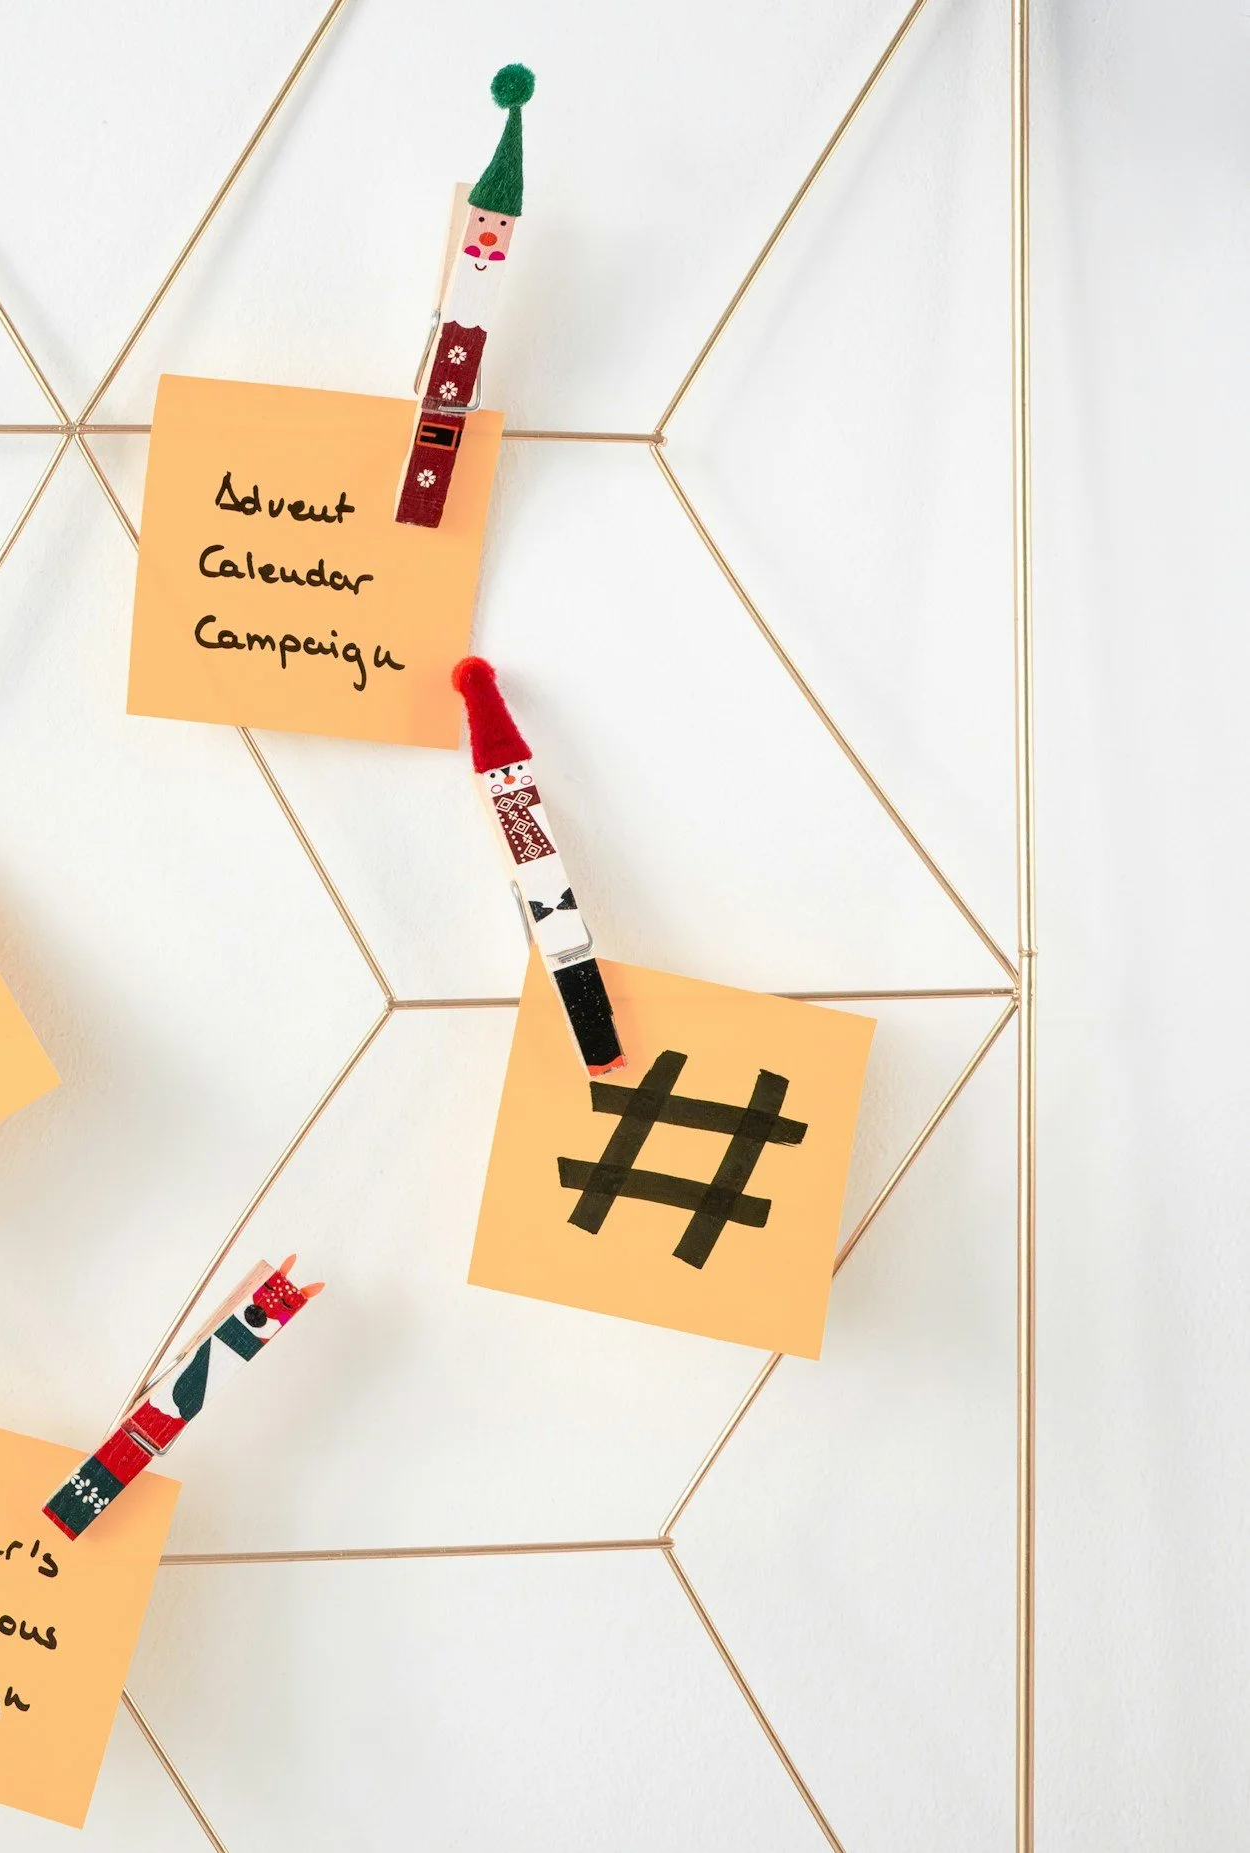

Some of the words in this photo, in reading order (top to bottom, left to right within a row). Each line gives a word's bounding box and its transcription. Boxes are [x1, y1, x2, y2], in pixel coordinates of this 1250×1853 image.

[214, 470, 356, 524] Advent
[198, 544, 374, 596] Calendar
[194, 614, 406, 692] Campaign
[556, 1049, 809, 1270] #
